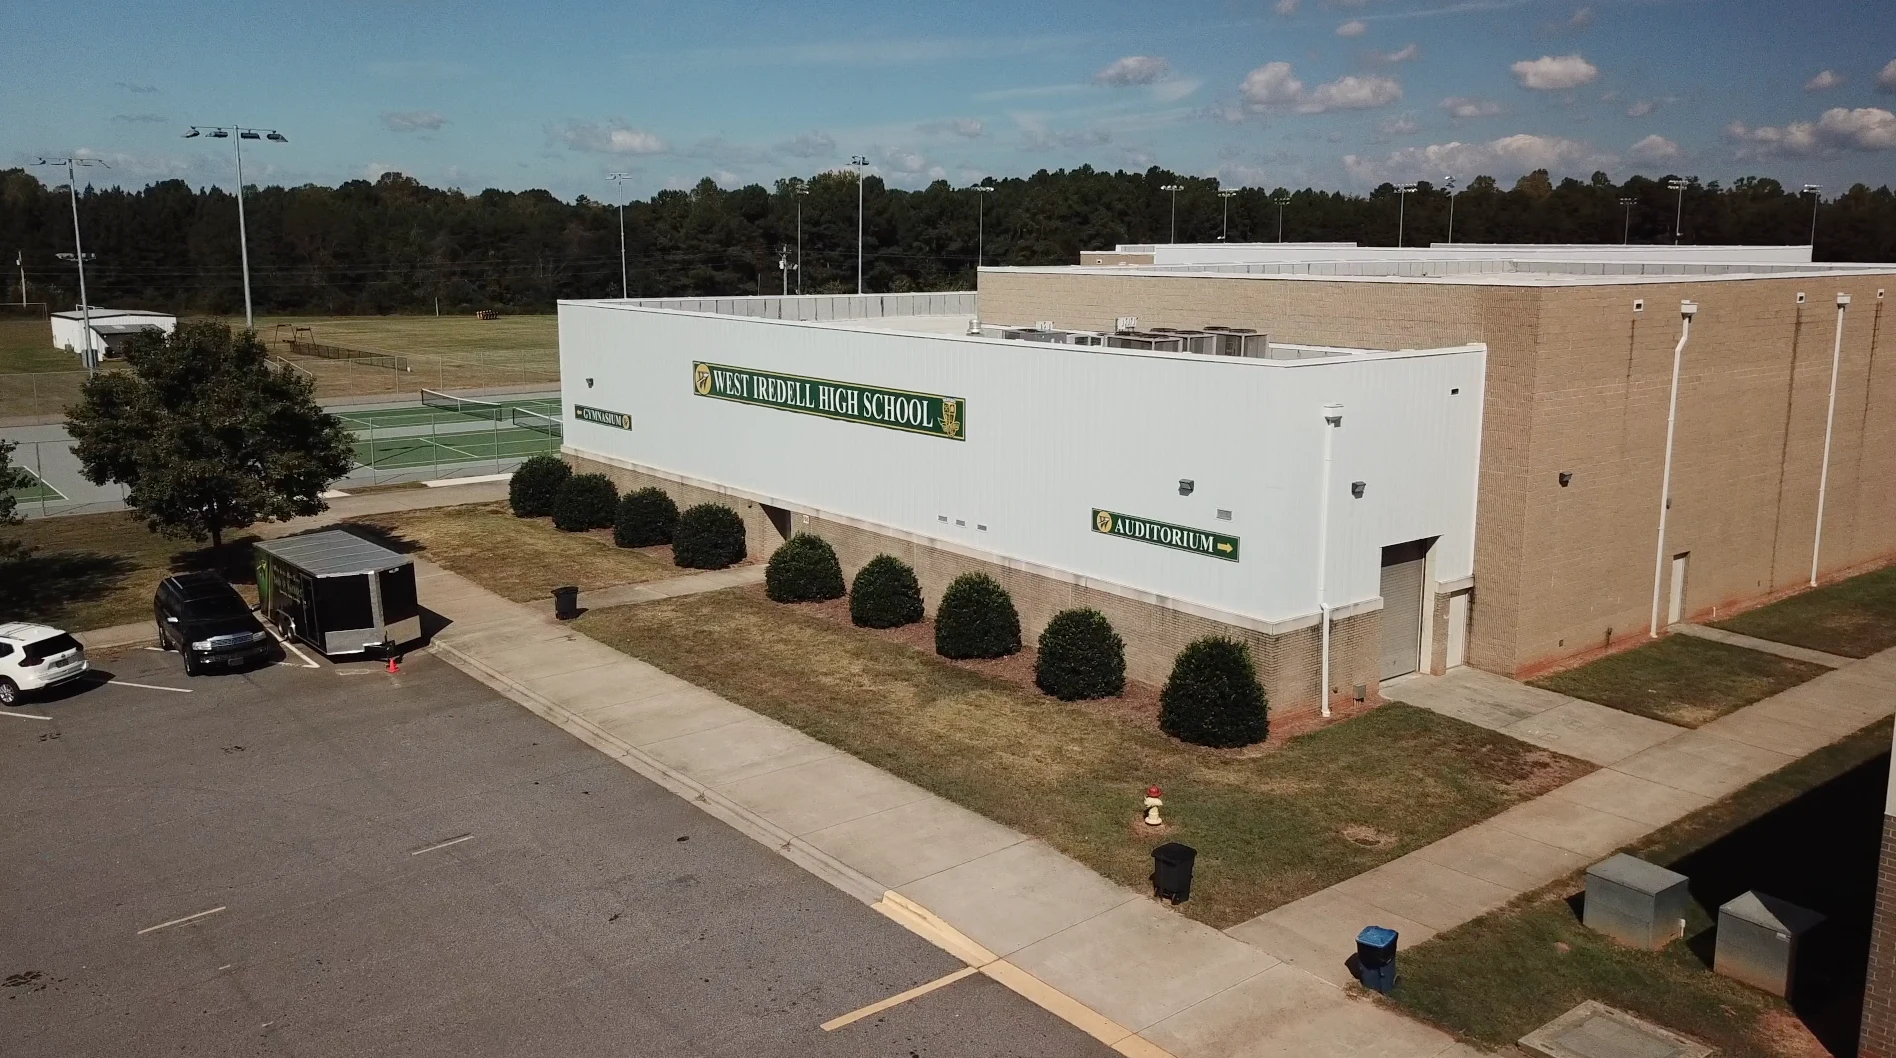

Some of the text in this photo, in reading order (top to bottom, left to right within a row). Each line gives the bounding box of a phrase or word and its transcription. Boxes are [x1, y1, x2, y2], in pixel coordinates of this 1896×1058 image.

[713, 369, 933, 427] WEST IREDELL HIGH SCHOOL
[583, 408, 622, 426] GYMNASIUM
[1114, 517, 1214, 552] AUDITORIUM
